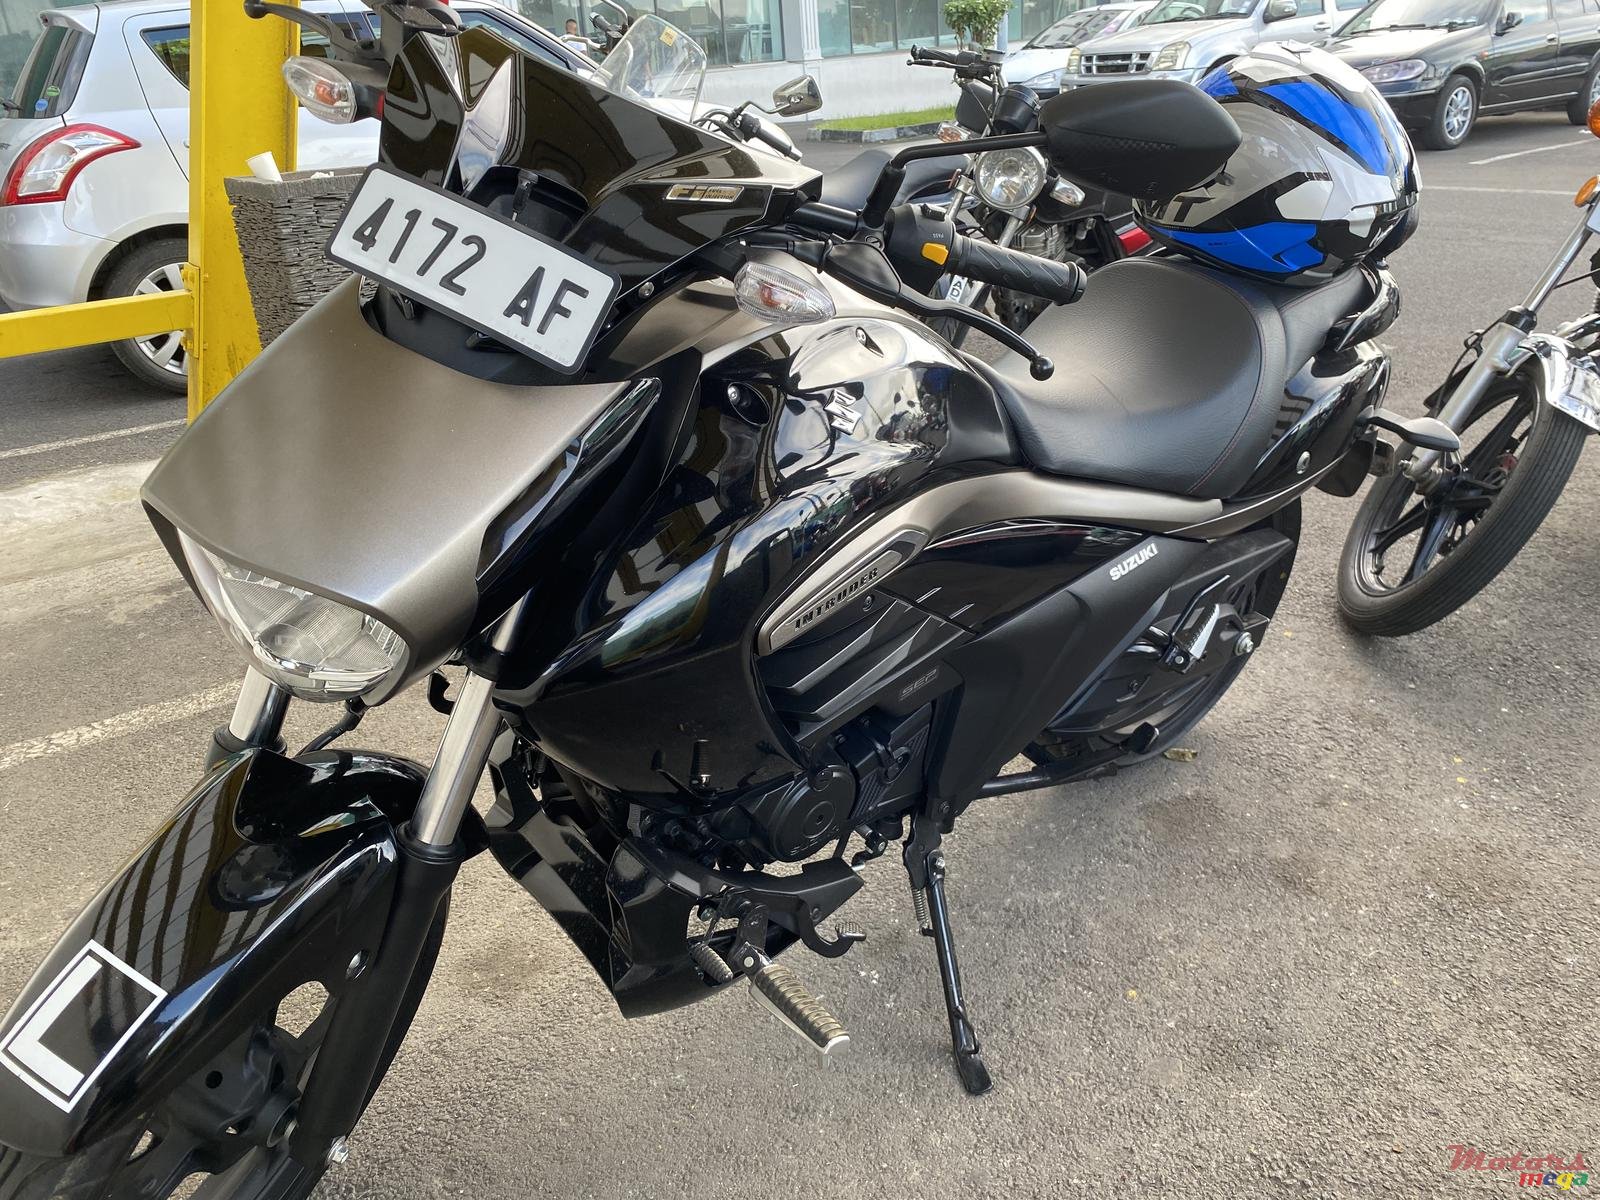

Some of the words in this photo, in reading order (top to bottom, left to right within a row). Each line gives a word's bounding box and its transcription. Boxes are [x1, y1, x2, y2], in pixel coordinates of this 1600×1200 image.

[352, 197, 487, 297] 4172
[502, 265, 590, 336] AF
[794, 567, 878, 631] INTRUDER
[1109, 542, 1159, 581] SUZUKI
[7, 955, 102, 1098] L
